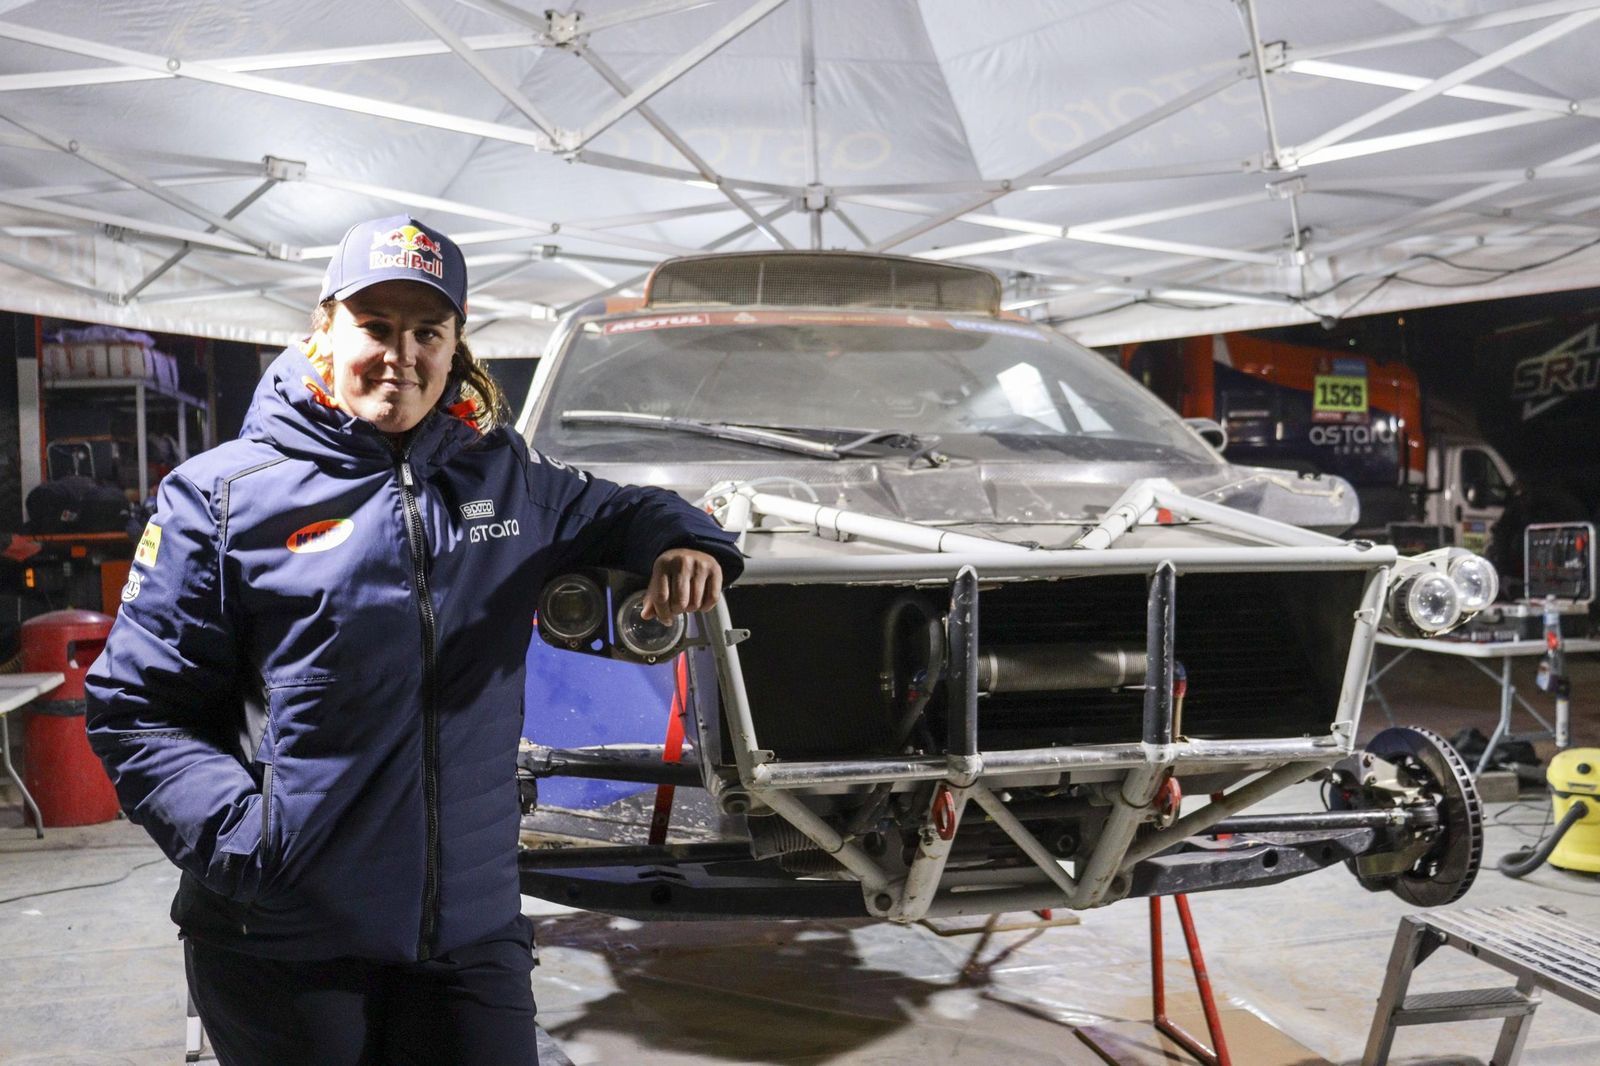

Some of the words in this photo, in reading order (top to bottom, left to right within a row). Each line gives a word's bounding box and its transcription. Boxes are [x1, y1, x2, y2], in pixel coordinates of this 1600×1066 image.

[369, 249, 408, 270] Red
[409, 251, 443, 279] Bull
[609, 314, 703, 332] MOTUL
[1318, 383, 1363, 407] 1526
